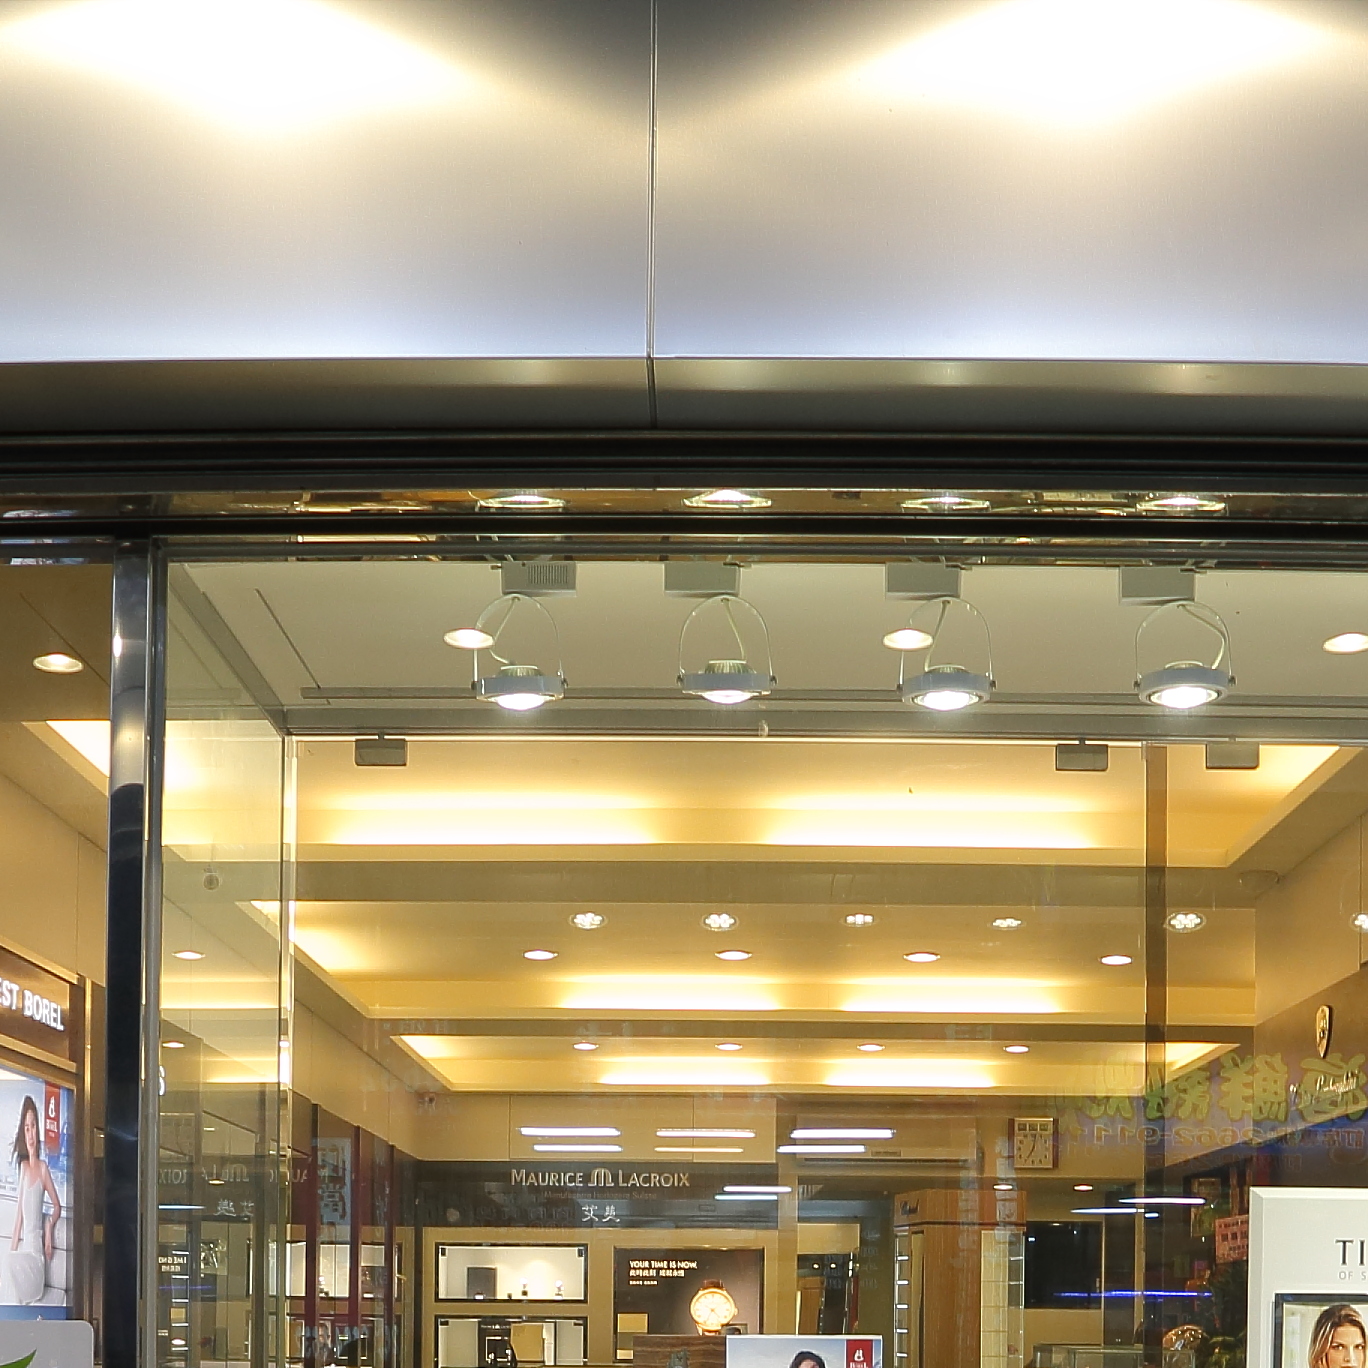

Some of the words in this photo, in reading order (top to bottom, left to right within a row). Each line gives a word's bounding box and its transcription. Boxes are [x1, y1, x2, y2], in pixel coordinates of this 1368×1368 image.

[23, 989, 65, 1031] BOREL
[511, 1168, 583, 1187] MAURICE
[619, 1169, 691, 1187] LACROIX
[629, 1260, 649, 1269] YOUR
[651, 1260, 668, 1269] TIME
[669, 1260, 677, 1269] IS
[1338, 1270, 1354, 1280] OF
